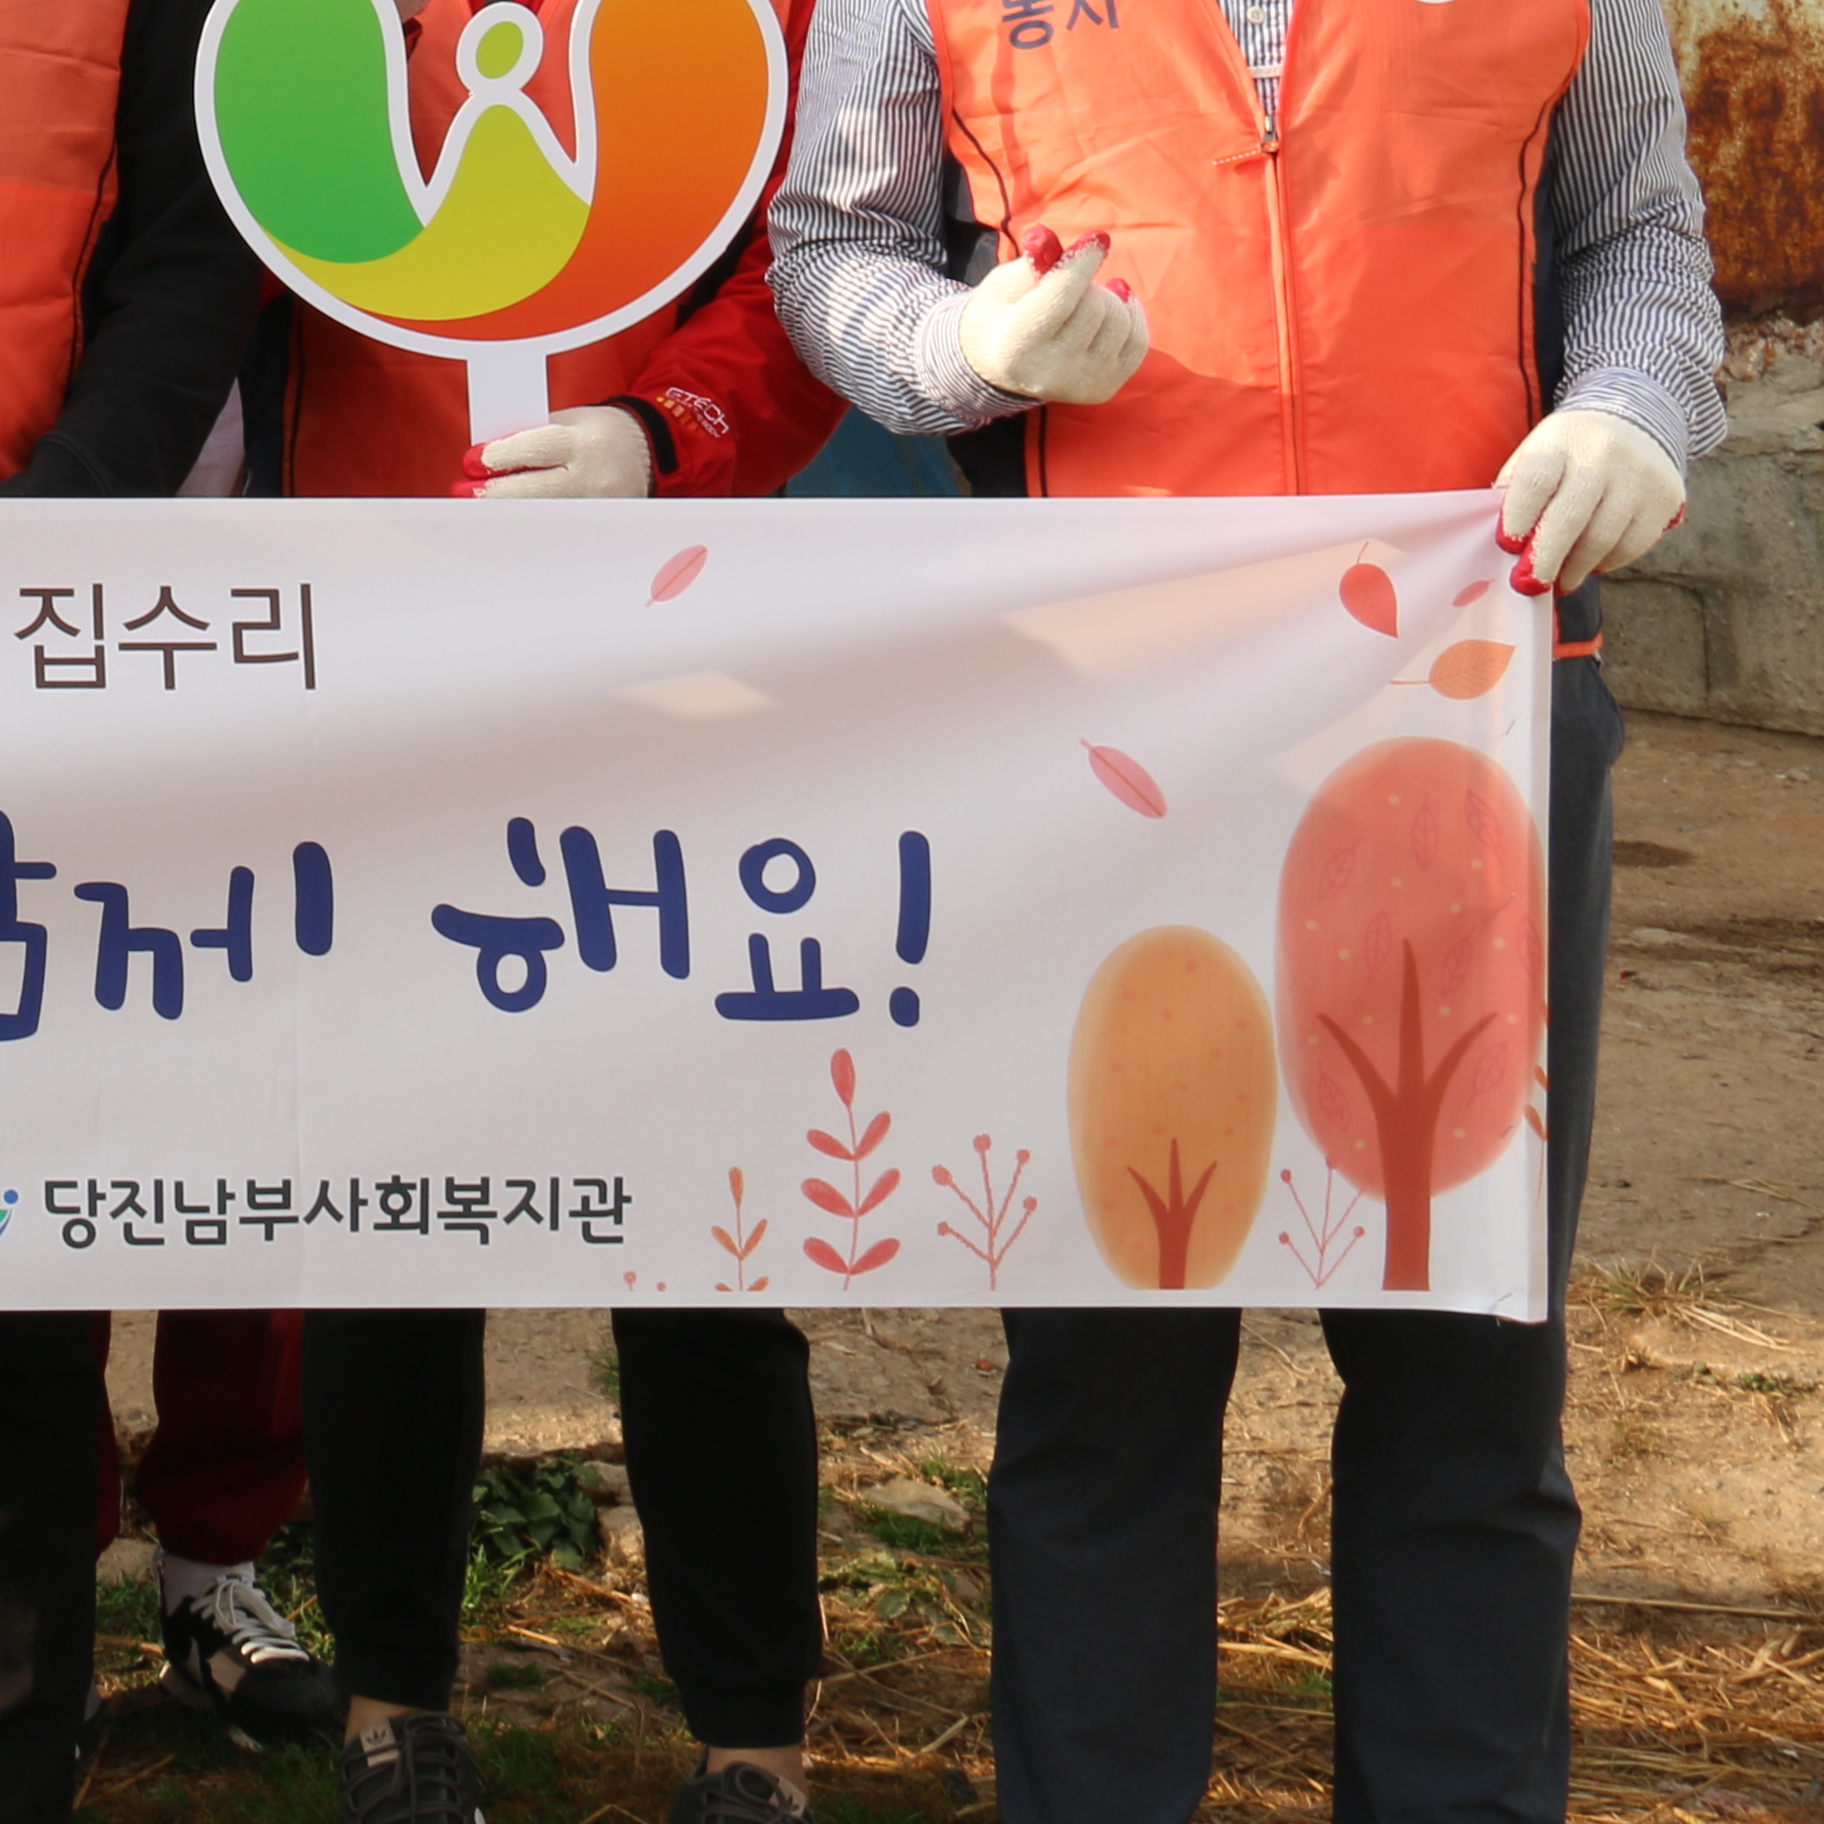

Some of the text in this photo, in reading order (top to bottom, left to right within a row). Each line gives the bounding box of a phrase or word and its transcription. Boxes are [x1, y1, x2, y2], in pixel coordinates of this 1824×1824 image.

[14, 583, 316, 691] 집수리
[431, 816, 931, 1027] 해요!
[44, 1175, 632, 1250] 당진남부사회복지관
